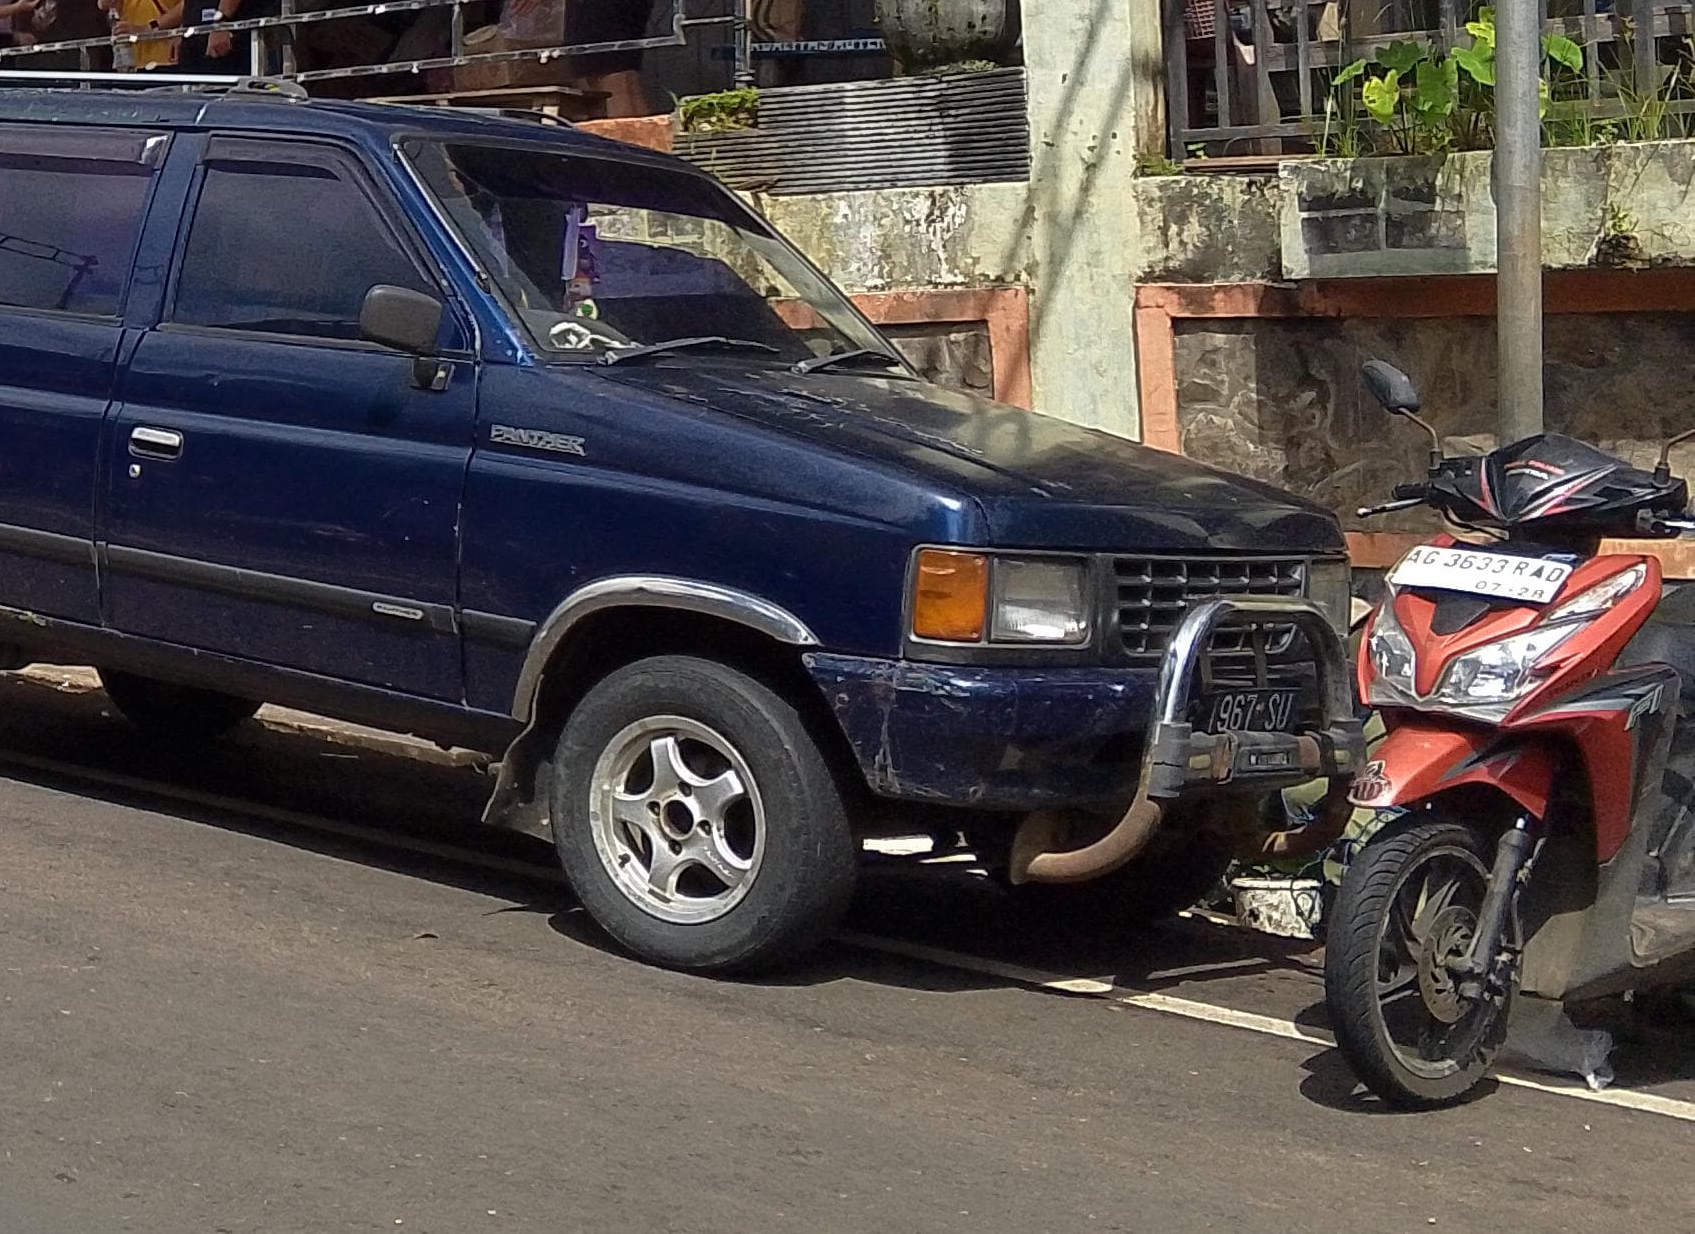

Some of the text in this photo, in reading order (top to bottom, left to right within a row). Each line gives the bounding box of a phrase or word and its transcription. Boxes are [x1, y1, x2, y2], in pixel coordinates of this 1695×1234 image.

[489, 424, 586, 457] PANTHER
[1407, 549, 1441, 565] AG
[1443, 553, 1509, 574] 3633
[1208, 693, 1294, 733] 1967 SU
